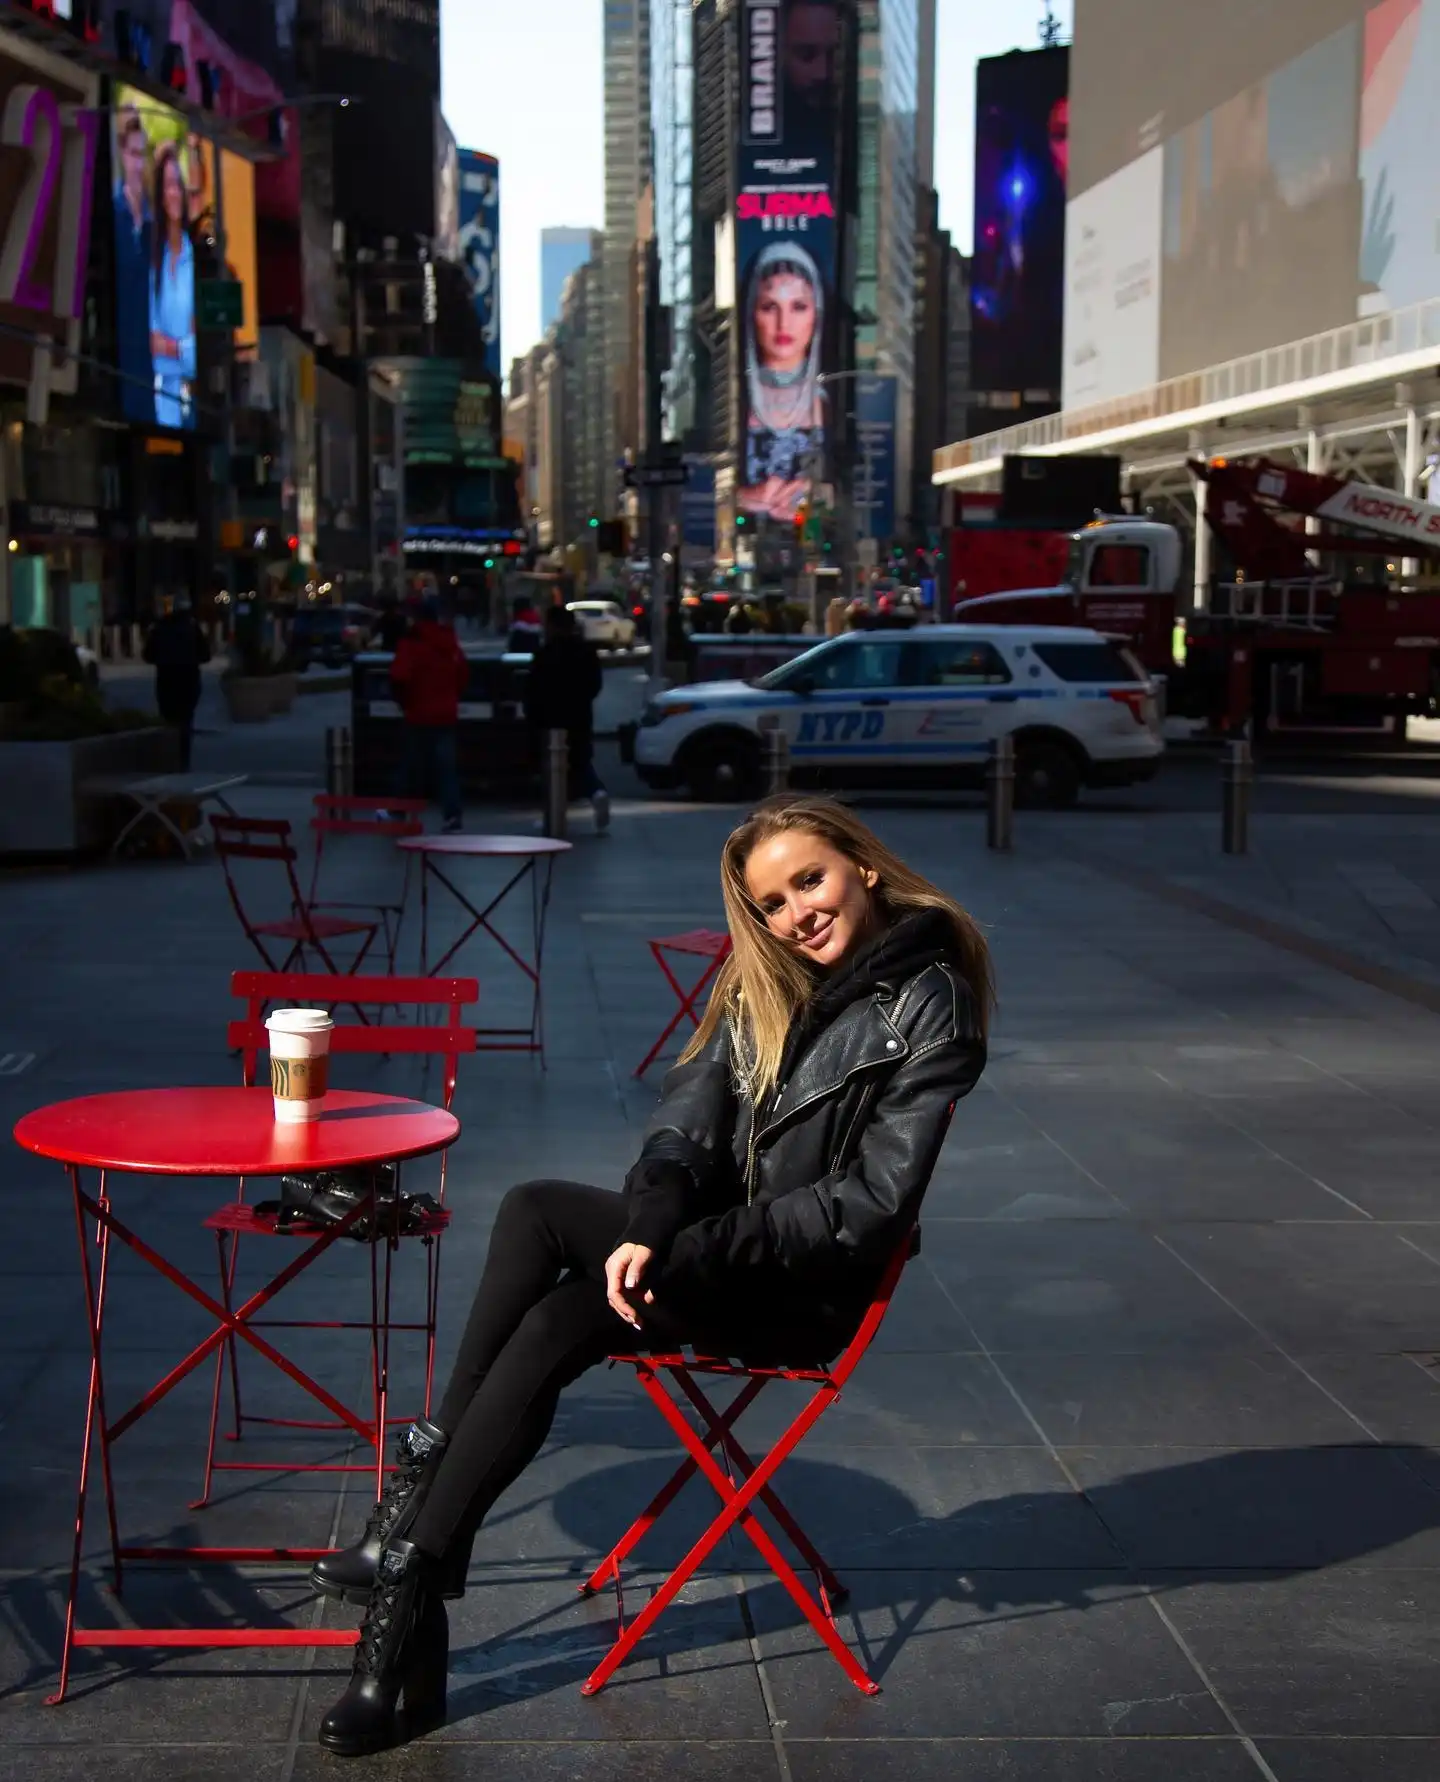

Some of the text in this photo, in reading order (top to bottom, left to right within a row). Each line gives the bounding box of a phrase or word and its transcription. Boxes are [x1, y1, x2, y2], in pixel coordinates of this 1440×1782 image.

[750, 8, 775, 134] BRAND
[3, 85, 99, 318] 21
[1344, 494, 1424, 531] NORTH
[797, 711, 884, 742] NYPD
